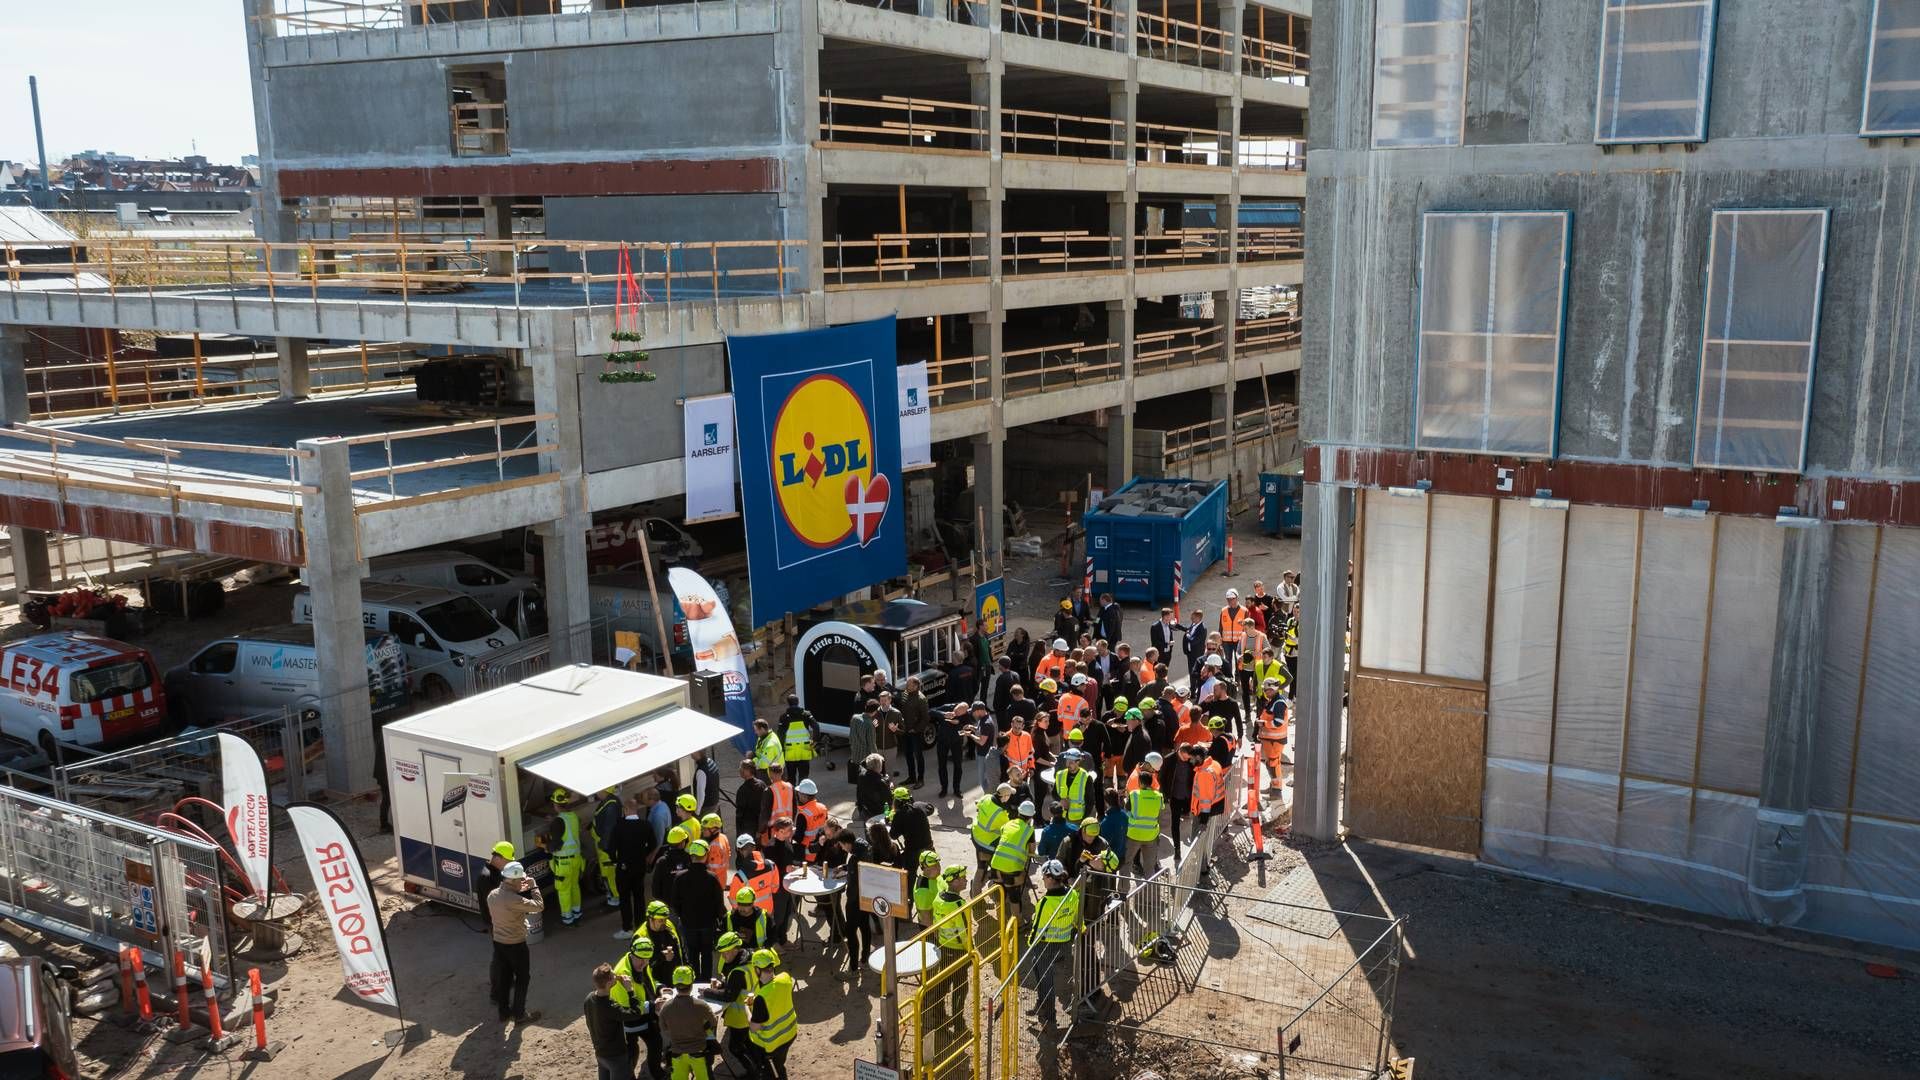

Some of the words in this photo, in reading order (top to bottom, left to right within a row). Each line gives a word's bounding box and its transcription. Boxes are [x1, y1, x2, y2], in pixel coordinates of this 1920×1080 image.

[899, 406, 928, 418] AARSLEFF
[690, 445, 731, 459] AARSLEFF
[588, 518, 642, 551] E34
[810, 637, 833, 656] Little
[834, 636, 872, 666] Donkey's
[251, 655, 273, 669] WIN
[0, 651, 60, 702] LE34
[140, 706, 160, 718] LE34
